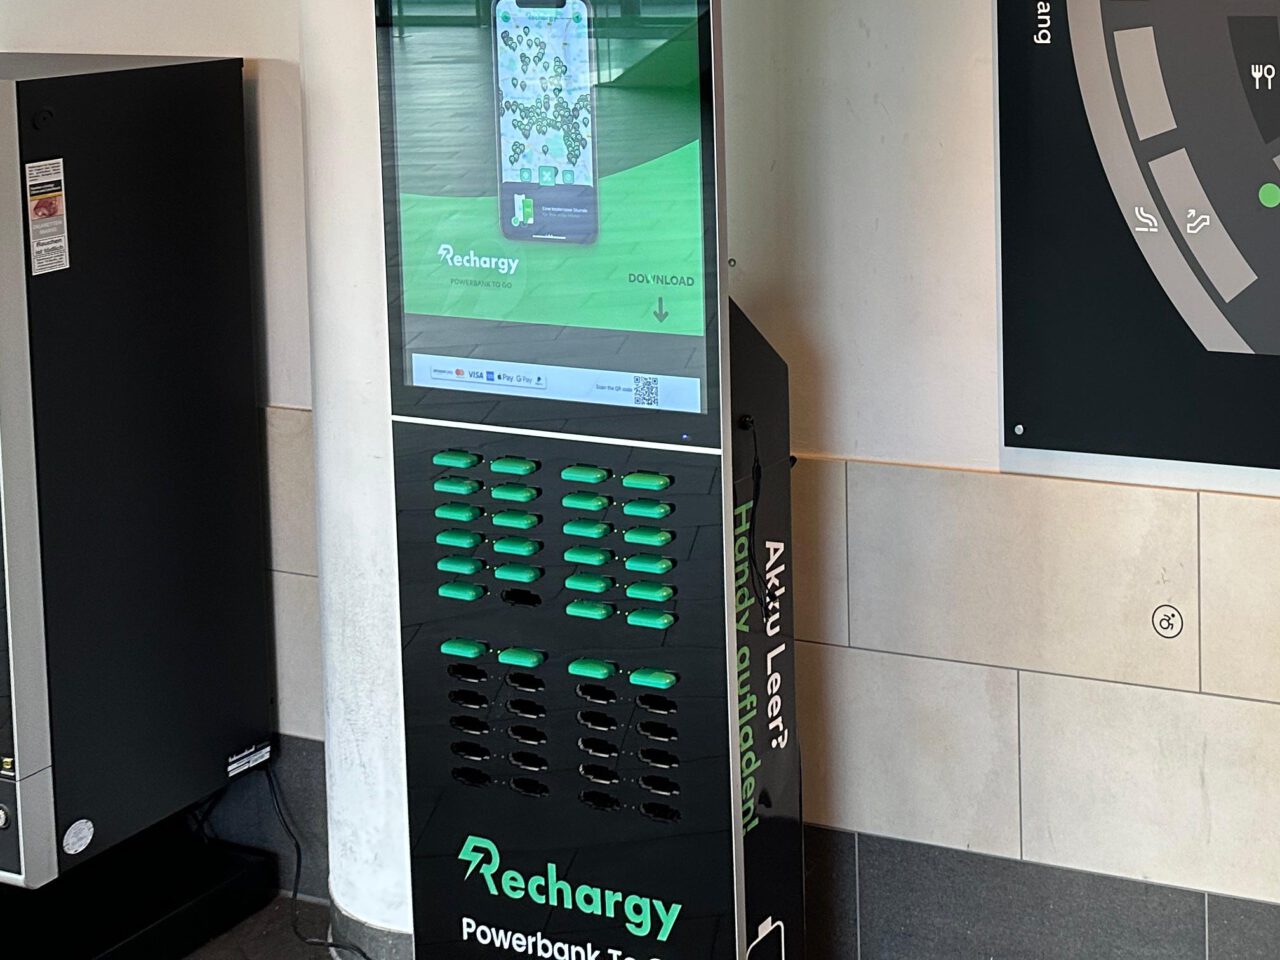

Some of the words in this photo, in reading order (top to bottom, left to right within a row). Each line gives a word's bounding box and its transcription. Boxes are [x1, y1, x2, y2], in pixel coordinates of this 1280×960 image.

[437, 244, 520, 275] Rechargy
[628, 272, 695, 287] DOWNLOAD
[468, 370, 484, 379] VISA
[734, 500, 755, 633] Handy
[766, 642, 788, 750] Leer?
[736, 644, 762, 837] aufladen!
[458, 835, 683, 942] Rechargy
[462, 916, 601, 960] Powerbank
